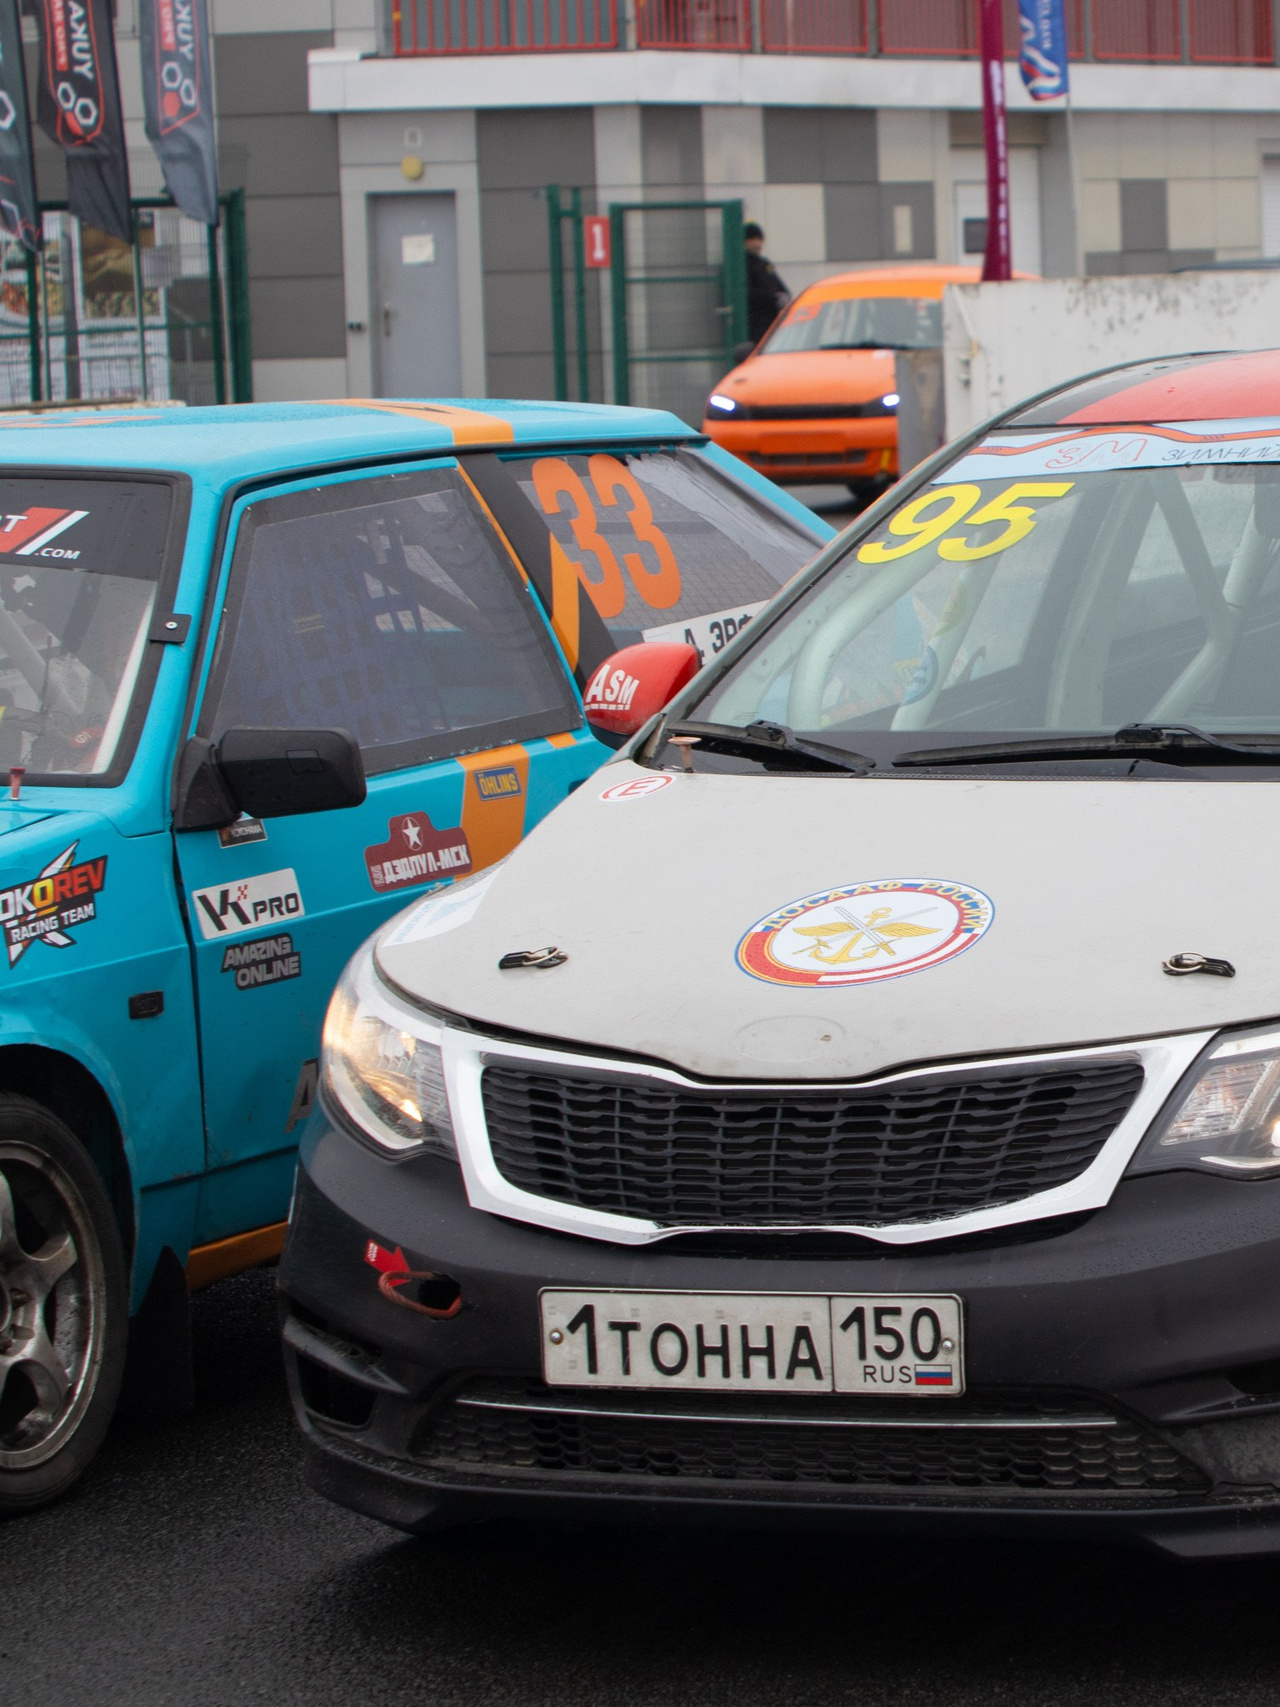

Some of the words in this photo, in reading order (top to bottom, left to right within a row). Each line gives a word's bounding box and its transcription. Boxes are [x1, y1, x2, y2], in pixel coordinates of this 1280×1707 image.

[591, 224, 606, 261] 1
[532, 453, 682, 618] 33
[857, 483, 1076, 564] 95
[585, 663, 640, 705] ASM
[479, 772, 518, 796] ÖHLINS
[620, 778, 655, 797] E
[11, 914, 60, 943] RACING
[61, 902, 95, 926] TEAM
[252, 892, 300, 922] PRO
[763, 880, 903, 929] ДОСААФ
[917, 881, 990, 930] РОССИИ
[223, 935, 292, 969] AMAZING
[237, 955, 299, 987] ONLINE
[838, 1304, 943, 1363] 150
[862, 1363, 913, 1385] RUS
